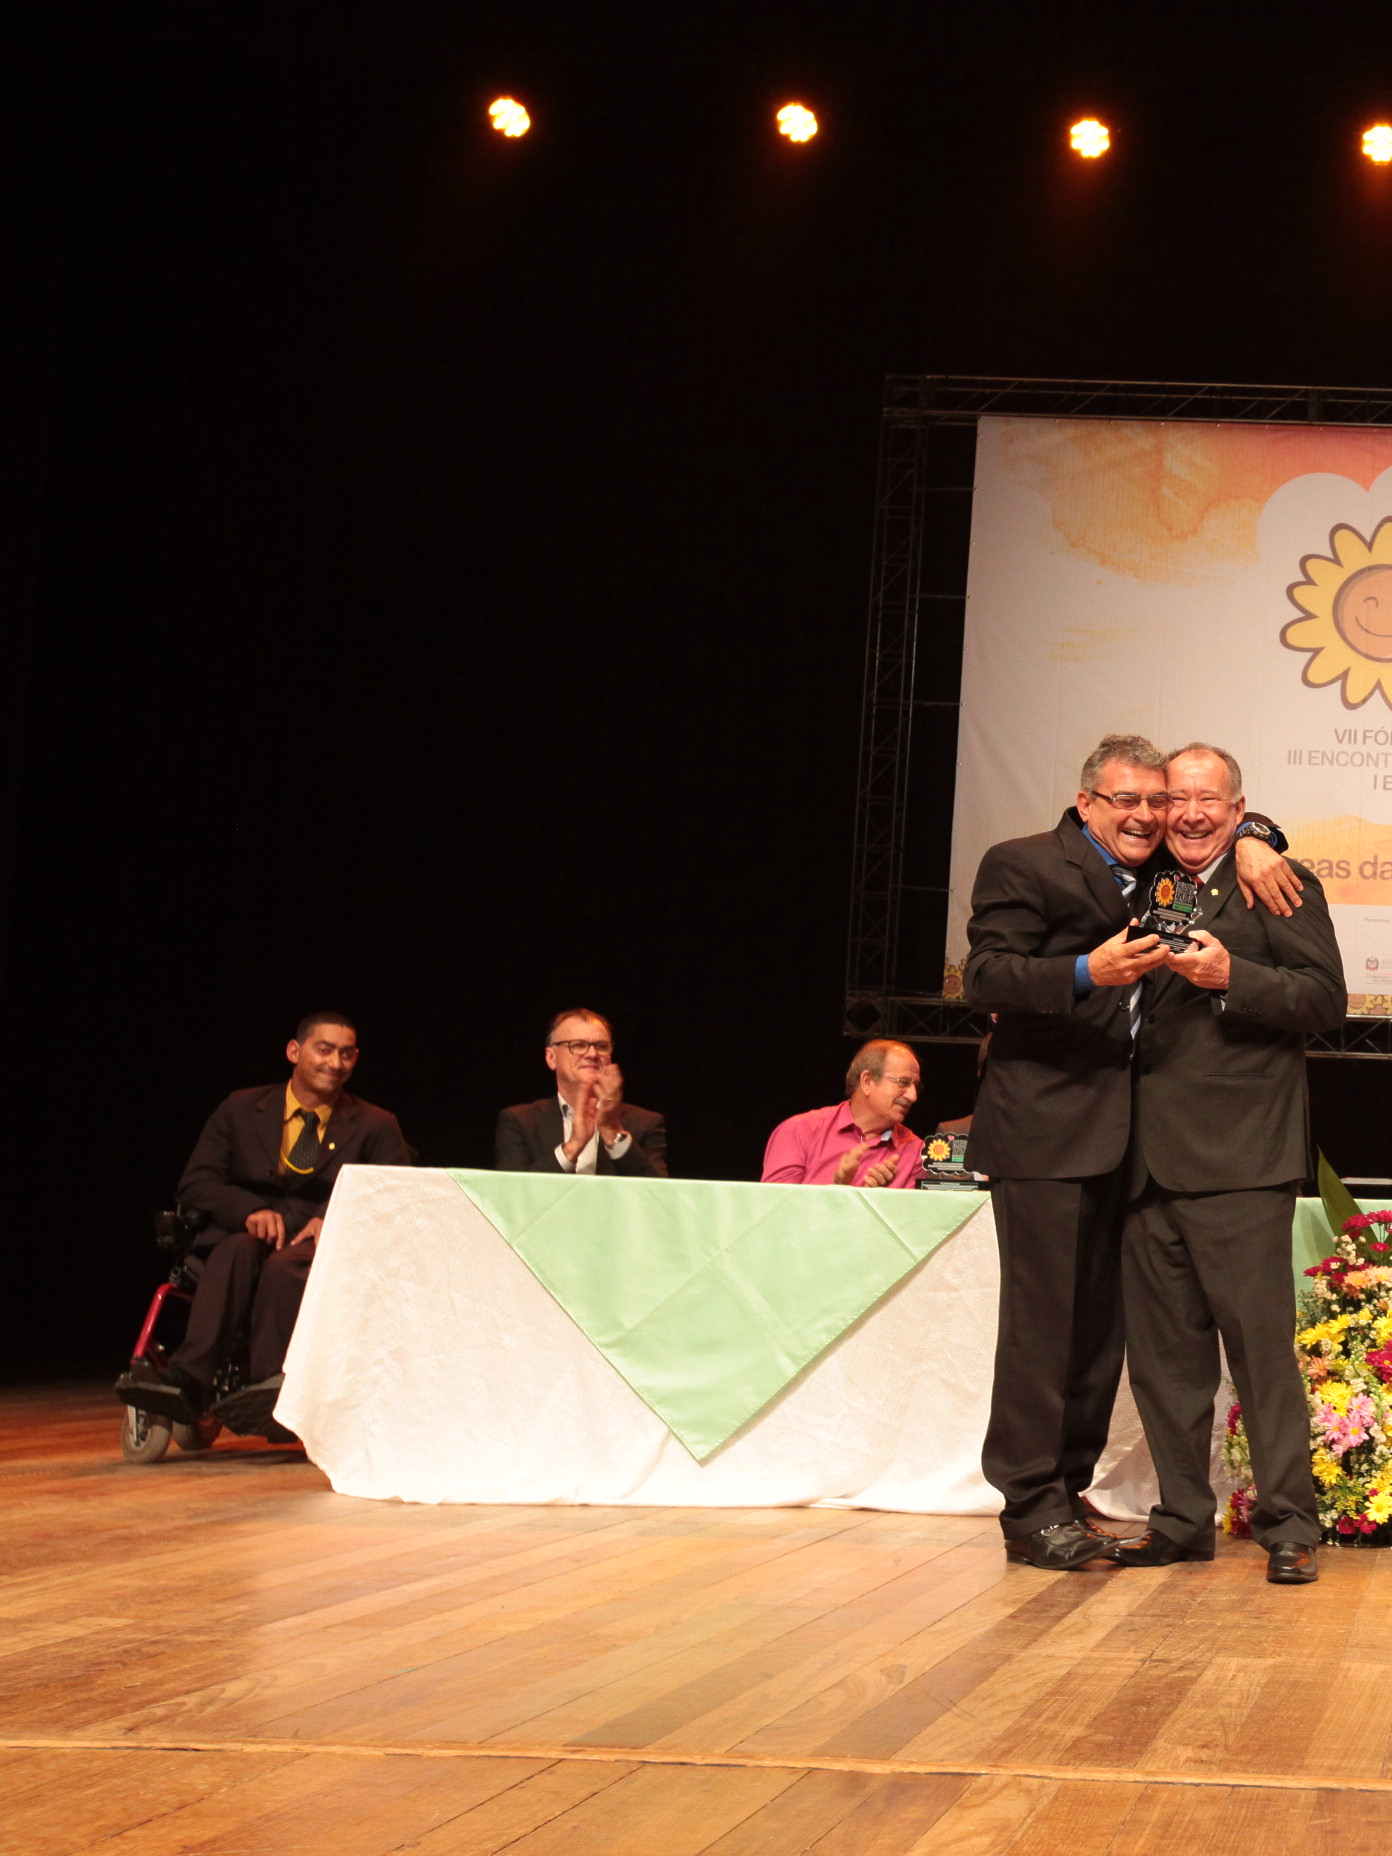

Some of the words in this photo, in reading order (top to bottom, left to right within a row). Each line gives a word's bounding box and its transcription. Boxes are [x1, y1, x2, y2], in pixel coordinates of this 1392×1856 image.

[1334, 728, 1357, 745] VII
[1287, 749, 1303, 765] III
[1373, 775, 1377, 790] I
